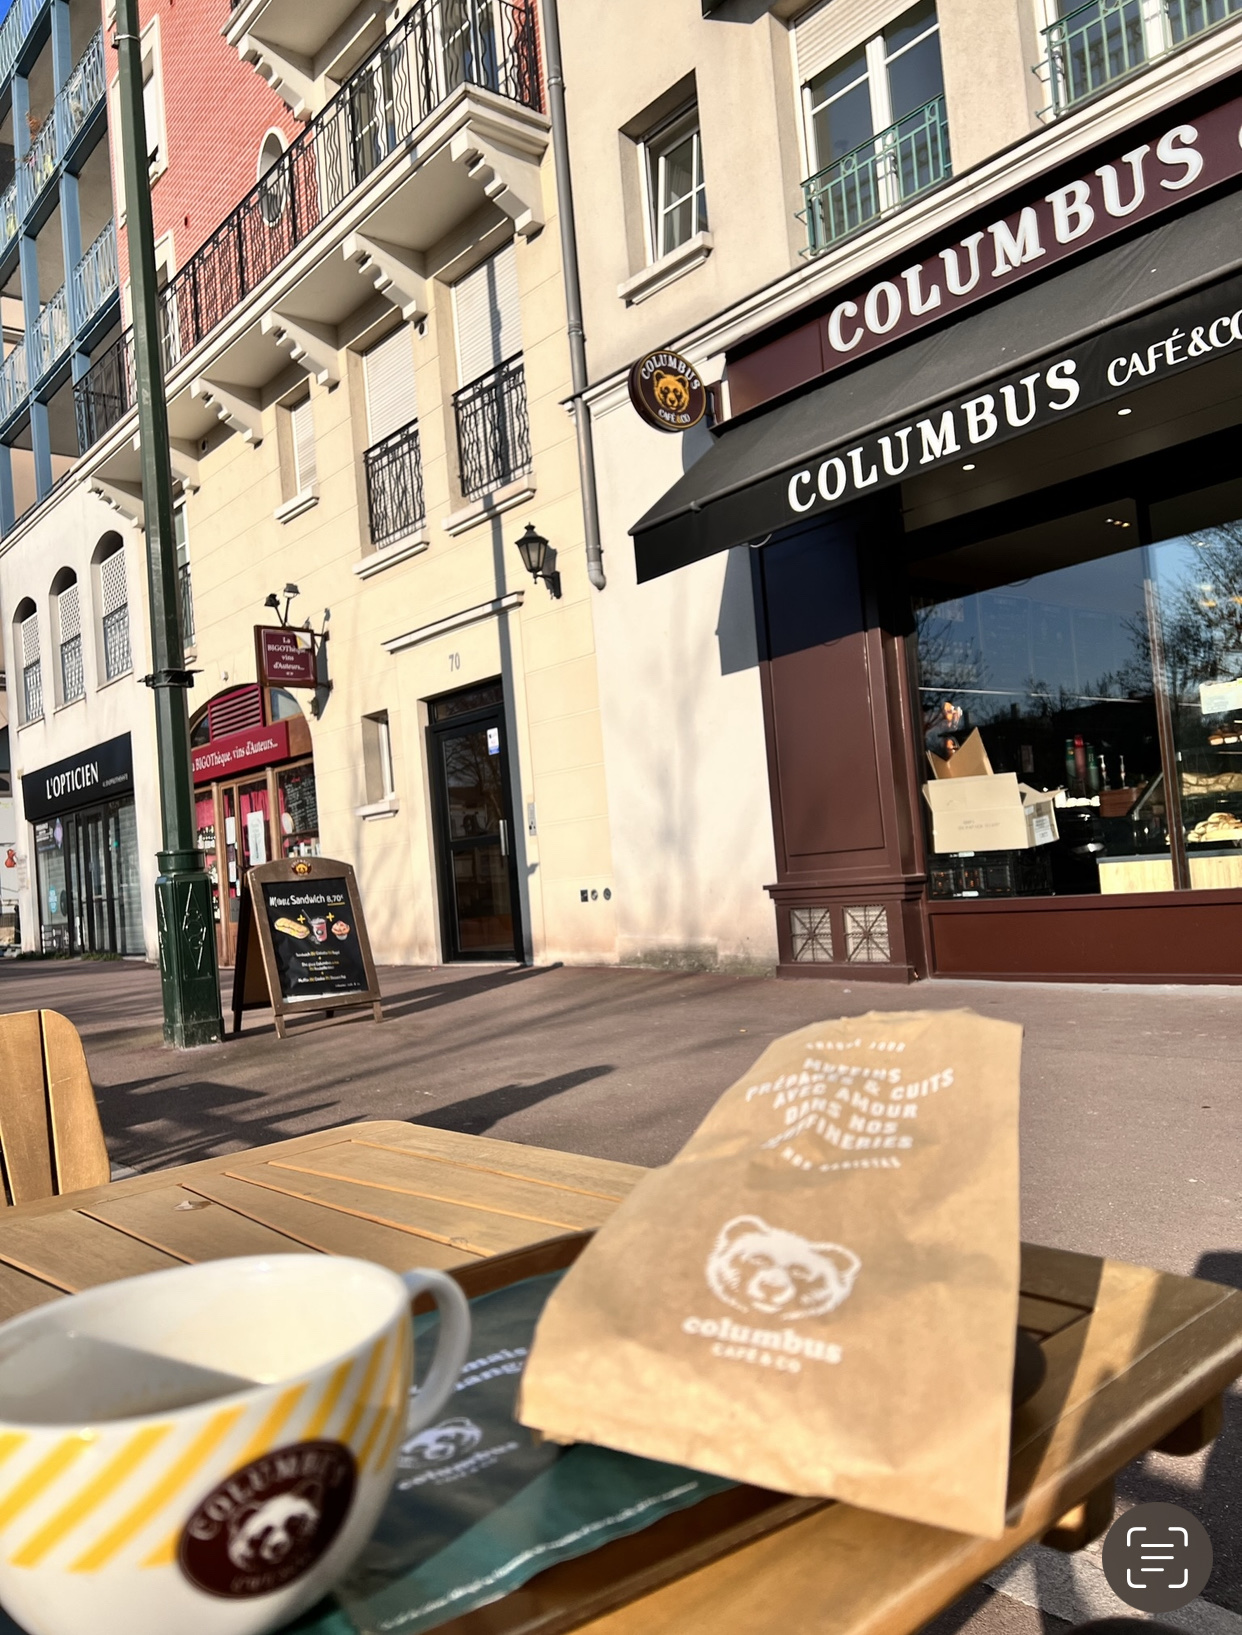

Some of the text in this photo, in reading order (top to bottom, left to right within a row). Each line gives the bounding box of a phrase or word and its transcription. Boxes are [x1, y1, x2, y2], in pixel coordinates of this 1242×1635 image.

[828, 124, 1204, 353] COLUMBUS
[641, 354, 700, 390] COLUMBUS
[787, 358, 1081, 513] COLUMBUS
[282, 636, 291, 644] La
[448, 652, 461, 672] 70
[232, 745, 246, 759] vins
[46, 761, 99, 800] L'OPTICIEN
[290, 893, 325, 906] Sandwich
[771, 1081, 919, 1119] AVEC AMOUR
[862, 1079, 882, 1098] &
[889, 1066, 956, 1102] CUITS
[783, 1096, 899, 1135] DANS NOS
[680, 1315, 843, 1366] columbus
